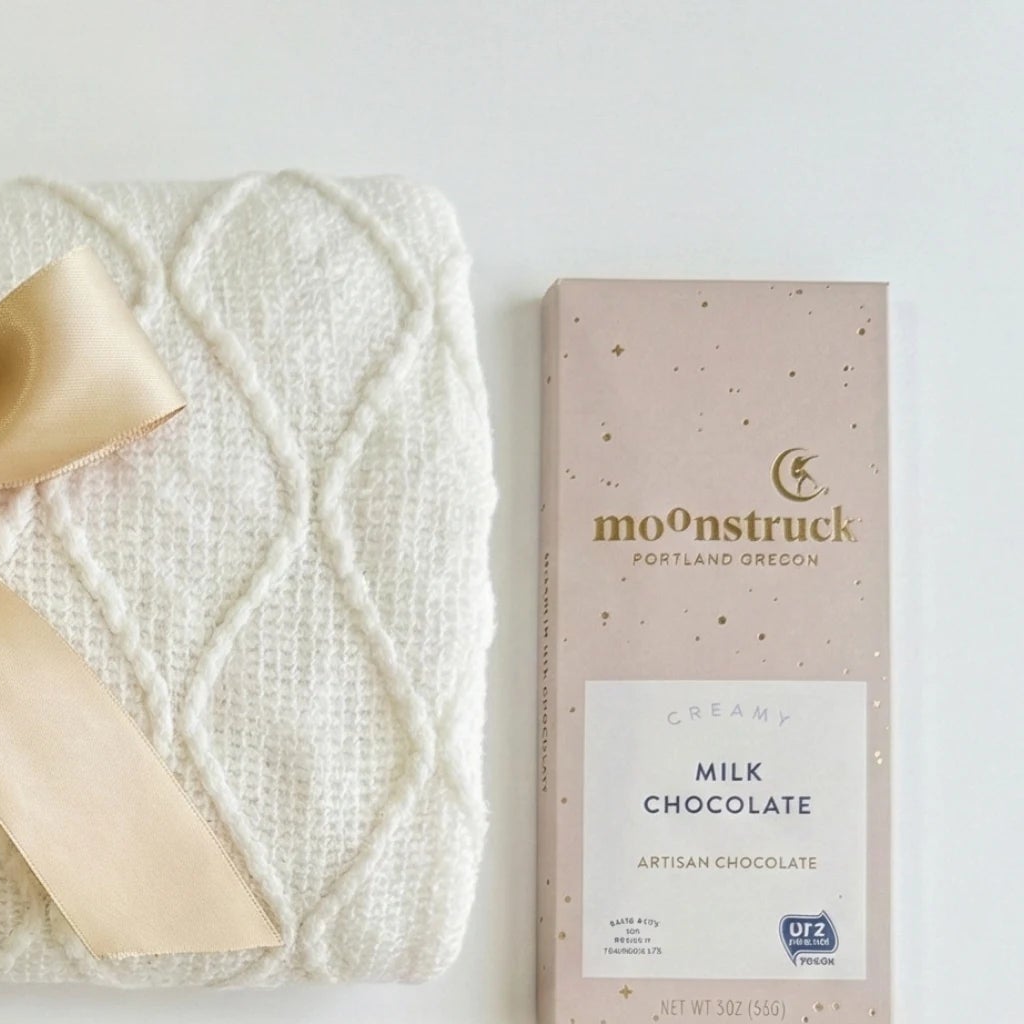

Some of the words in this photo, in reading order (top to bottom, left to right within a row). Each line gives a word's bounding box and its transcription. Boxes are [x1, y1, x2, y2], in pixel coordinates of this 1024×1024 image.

[593, 505, 857, 542] moonstruck
[632, 552, 733, 567] PORTLAND
[666, 702, 791, 728] CREAMY
[695, 762, 763, 782] MILK
[643, 795, 812, 815] CHOCOLATE
[637, 856, 710, 870] ARTISAN
[715, 856, 818, 870] CHOCOLATE
[660, 999, 686, 1016] NET
[691, 999, 712, 1016] WT
